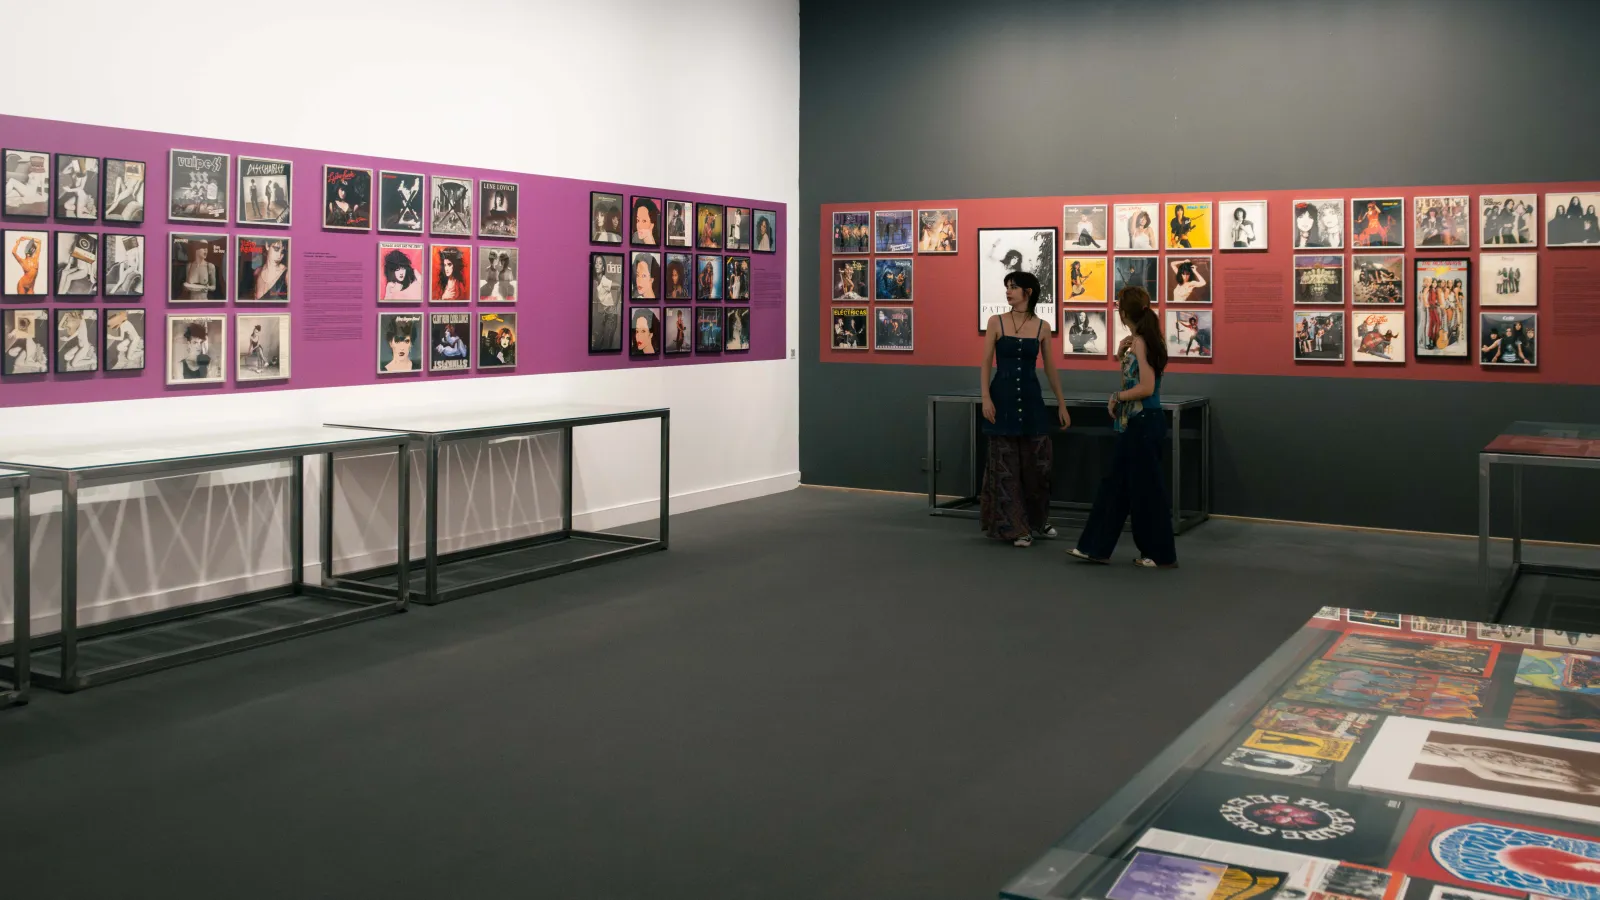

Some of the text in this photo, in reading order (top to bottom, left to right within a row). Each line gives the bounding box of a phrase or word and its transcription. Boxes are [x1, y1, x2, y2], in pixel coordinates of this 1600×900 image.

[496, 184, 515, 192] LOVICH
[1218, 794, 1356, 842] PLEASURE SEEKERS
